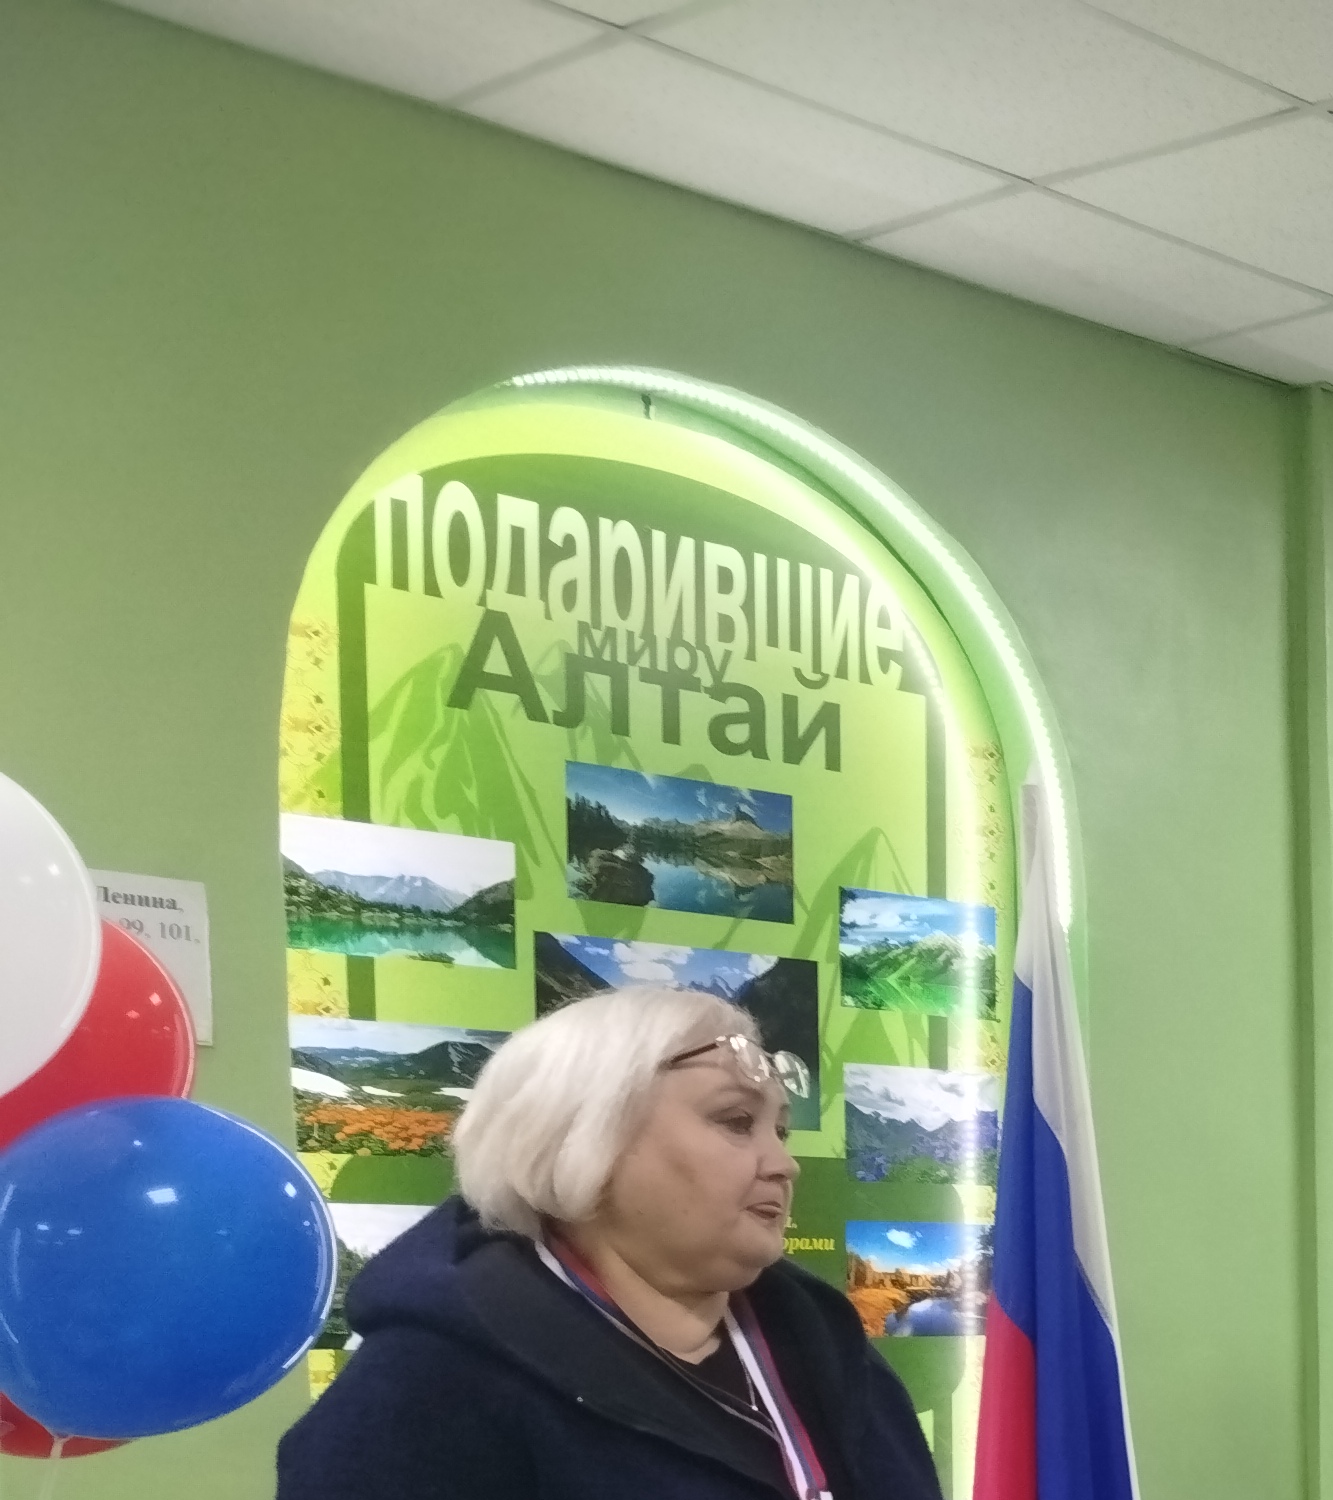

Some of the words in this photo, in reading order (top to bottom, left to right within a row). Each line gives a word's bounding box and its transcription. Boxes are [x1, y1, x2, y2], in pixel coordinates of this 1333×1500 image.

[374, 474, 903, 690] подарившие
[447, 606, 842, 772] Алтай
[576, 620, 732, 686] миру
[159, 921, 201, 944] 101,
